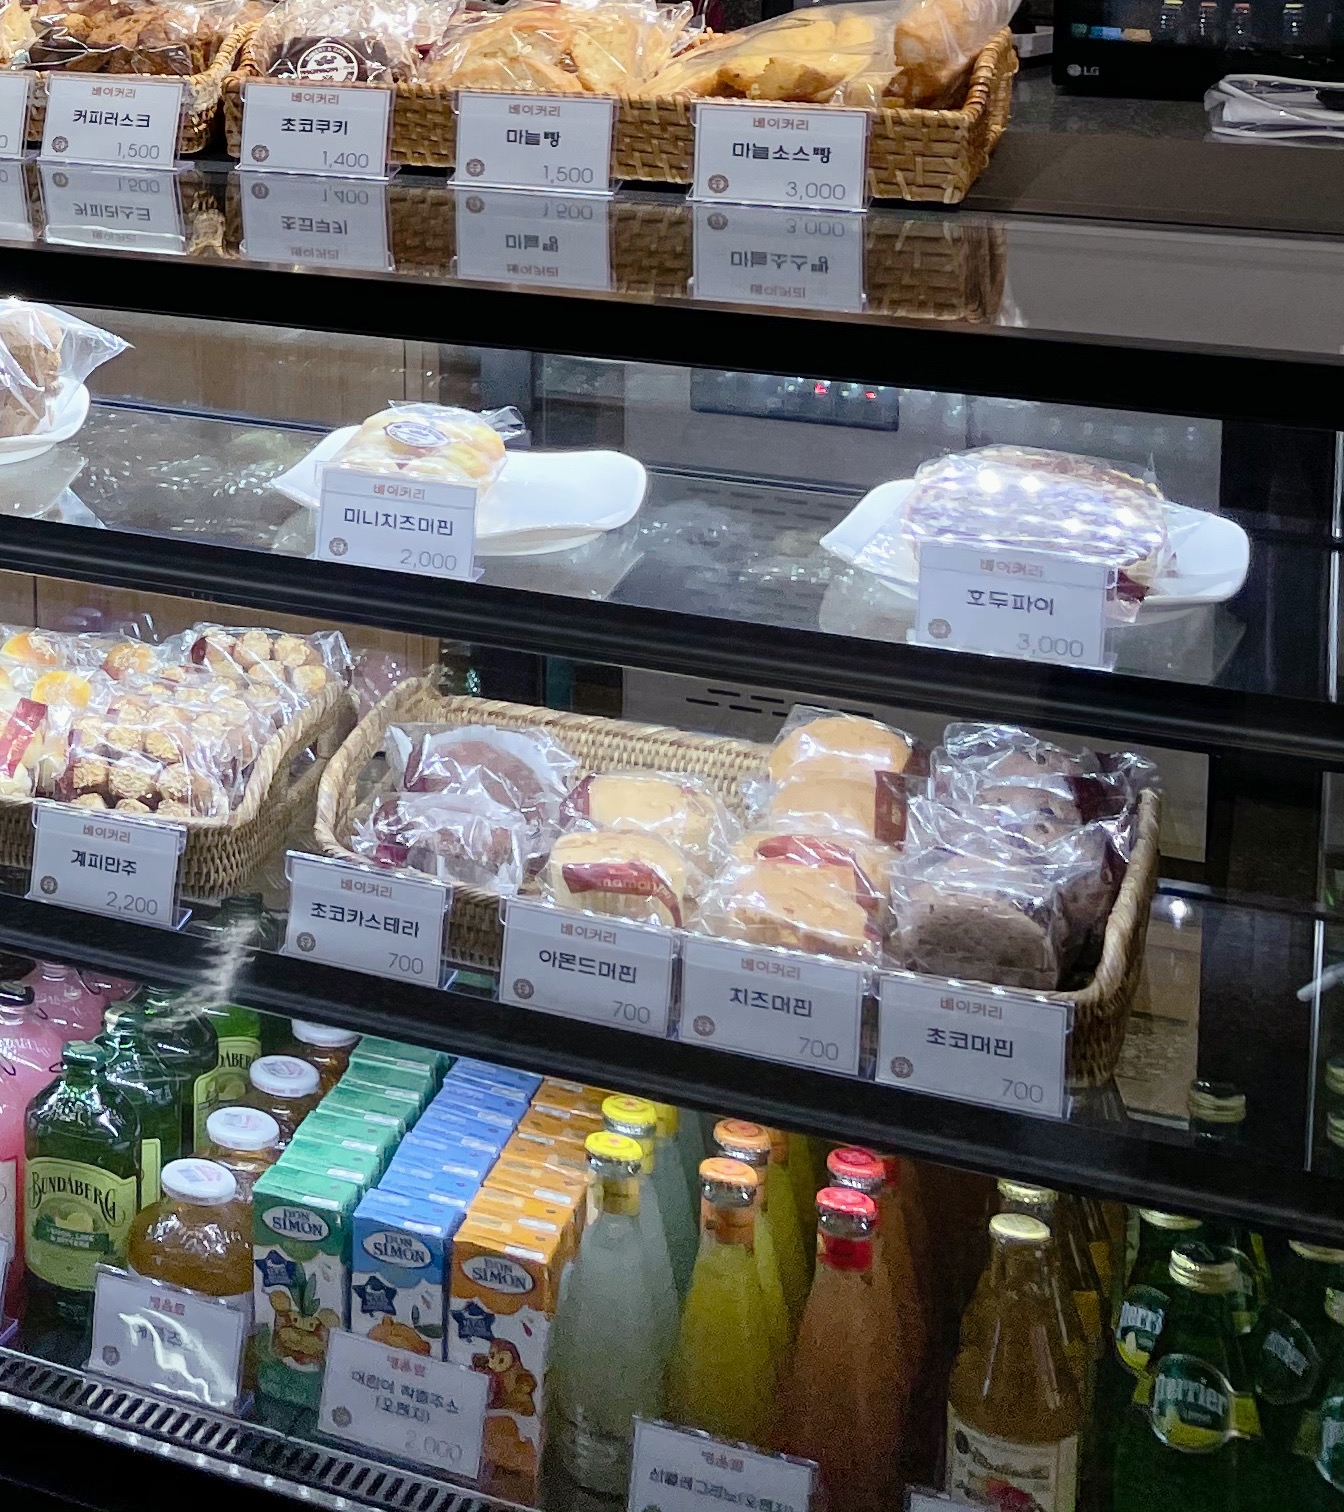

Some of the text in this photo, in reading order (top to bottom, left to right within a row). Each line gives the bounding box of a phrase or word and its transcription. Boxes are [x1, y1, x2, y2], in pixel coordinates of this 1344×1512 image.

[1083, 66, 1100, 77] LG
[72, 108, 151, 129] 커피러스크
[280, 116, 349, 137] 초코쿠키
[506, 127, 561, 149] 마늘빵
[116, 141, 160, 161] 1,500
[320, 149, 370, 170] 1,400
[731, 140, 832, 165] 마늘소스빵
[542, 164, 594, 185] 1,500
[784, 180, 847, 202] 3,000
[343, 506, 454, 539] 미니치즈머핀
[400, 548, 458, 573] 2,000
[966, 588, 1055, 616] 호두파이
[1017, 632, 1085, 659] 3,000
[70, 848, 138, 877] 계피만주
[106, 890, 159, 917] 2,200
[309, 900, 421, 941] 초코카스테라
[387, 951, 425, 976] 700
[538, 946, 639, 985] 아몬드머핀
[611, 999, 652, 1025] 700
[730, 984, 814, 1020] 치즈머핀
[798, 1035, 841, 1062] 700
[925, 1025, 1016, 1060] 초코머핀
[1001, 1076, 1046, 1104] 700
[32, 1170, 116, 1228] BUNDABERG
[272, 1217, 324, 1238] SIMON
[373, 1242, 426, 1263] SIMON
[472, 1268, 526, 1290] SIMON
